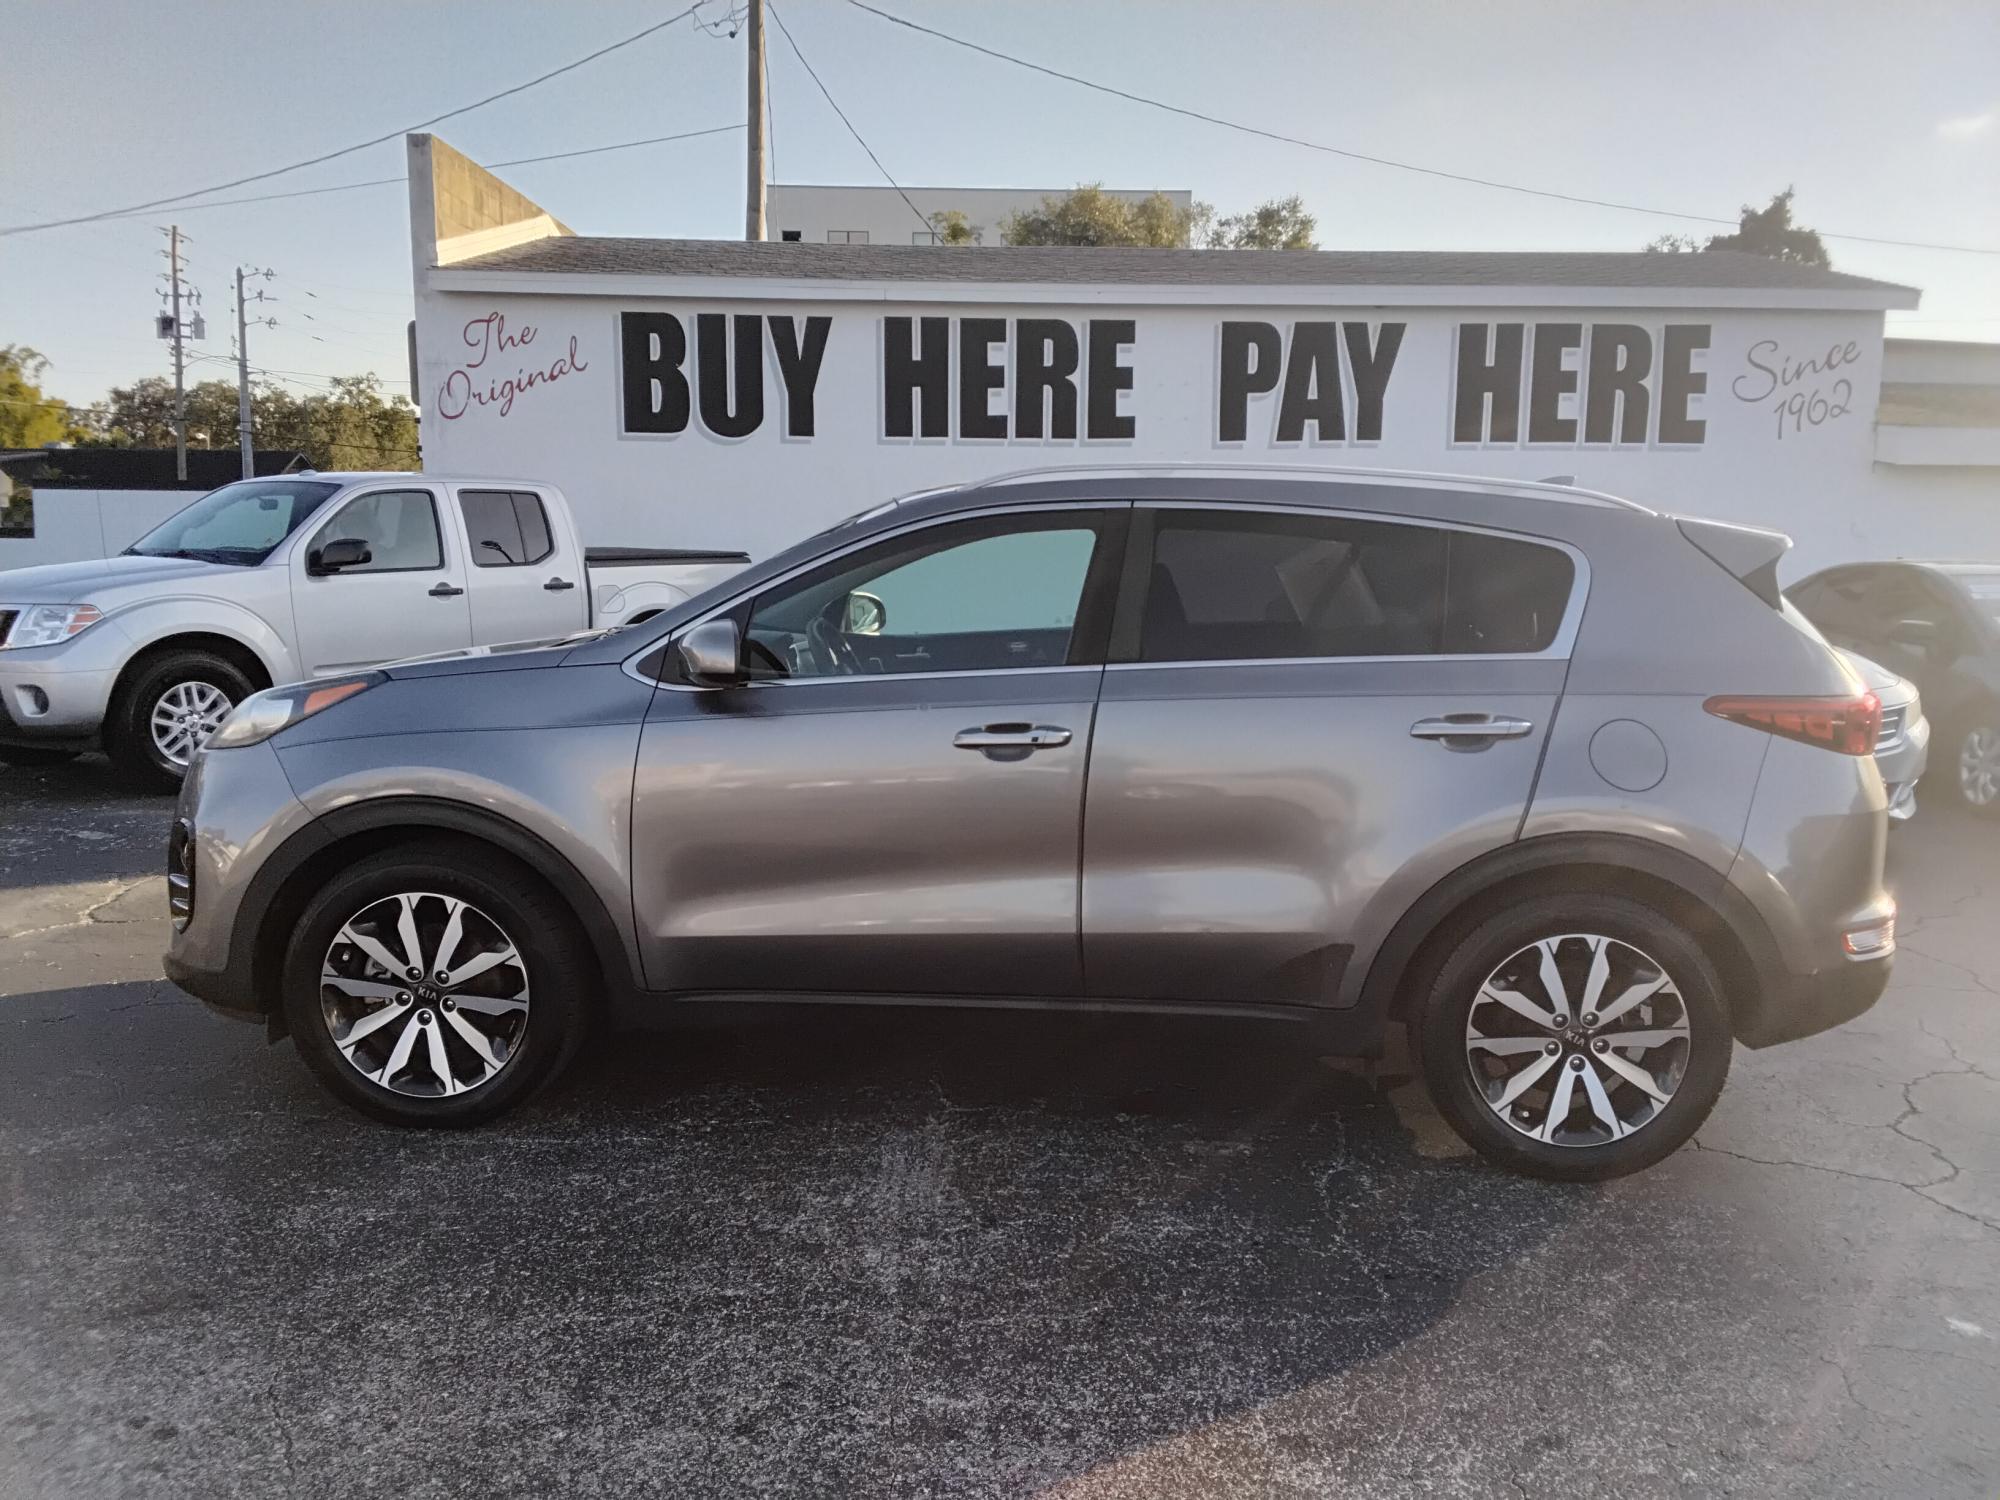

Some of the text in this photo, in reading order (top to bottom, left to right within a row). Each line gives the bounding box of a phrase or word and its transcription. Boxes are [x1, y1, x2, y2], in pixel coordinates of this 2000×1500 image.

[463, 311, 538, 368] The
[438, 335, 588, 419] Original
[618, 311, 1713, 445] BUY HERE PAY HERE
[1732, 340, 1863, 403] Since
[1773, 379, 1854, 440] 1962
[417, 986, 437, 1000] KIA
[1564, 1030, 1586, 1047] KIA
